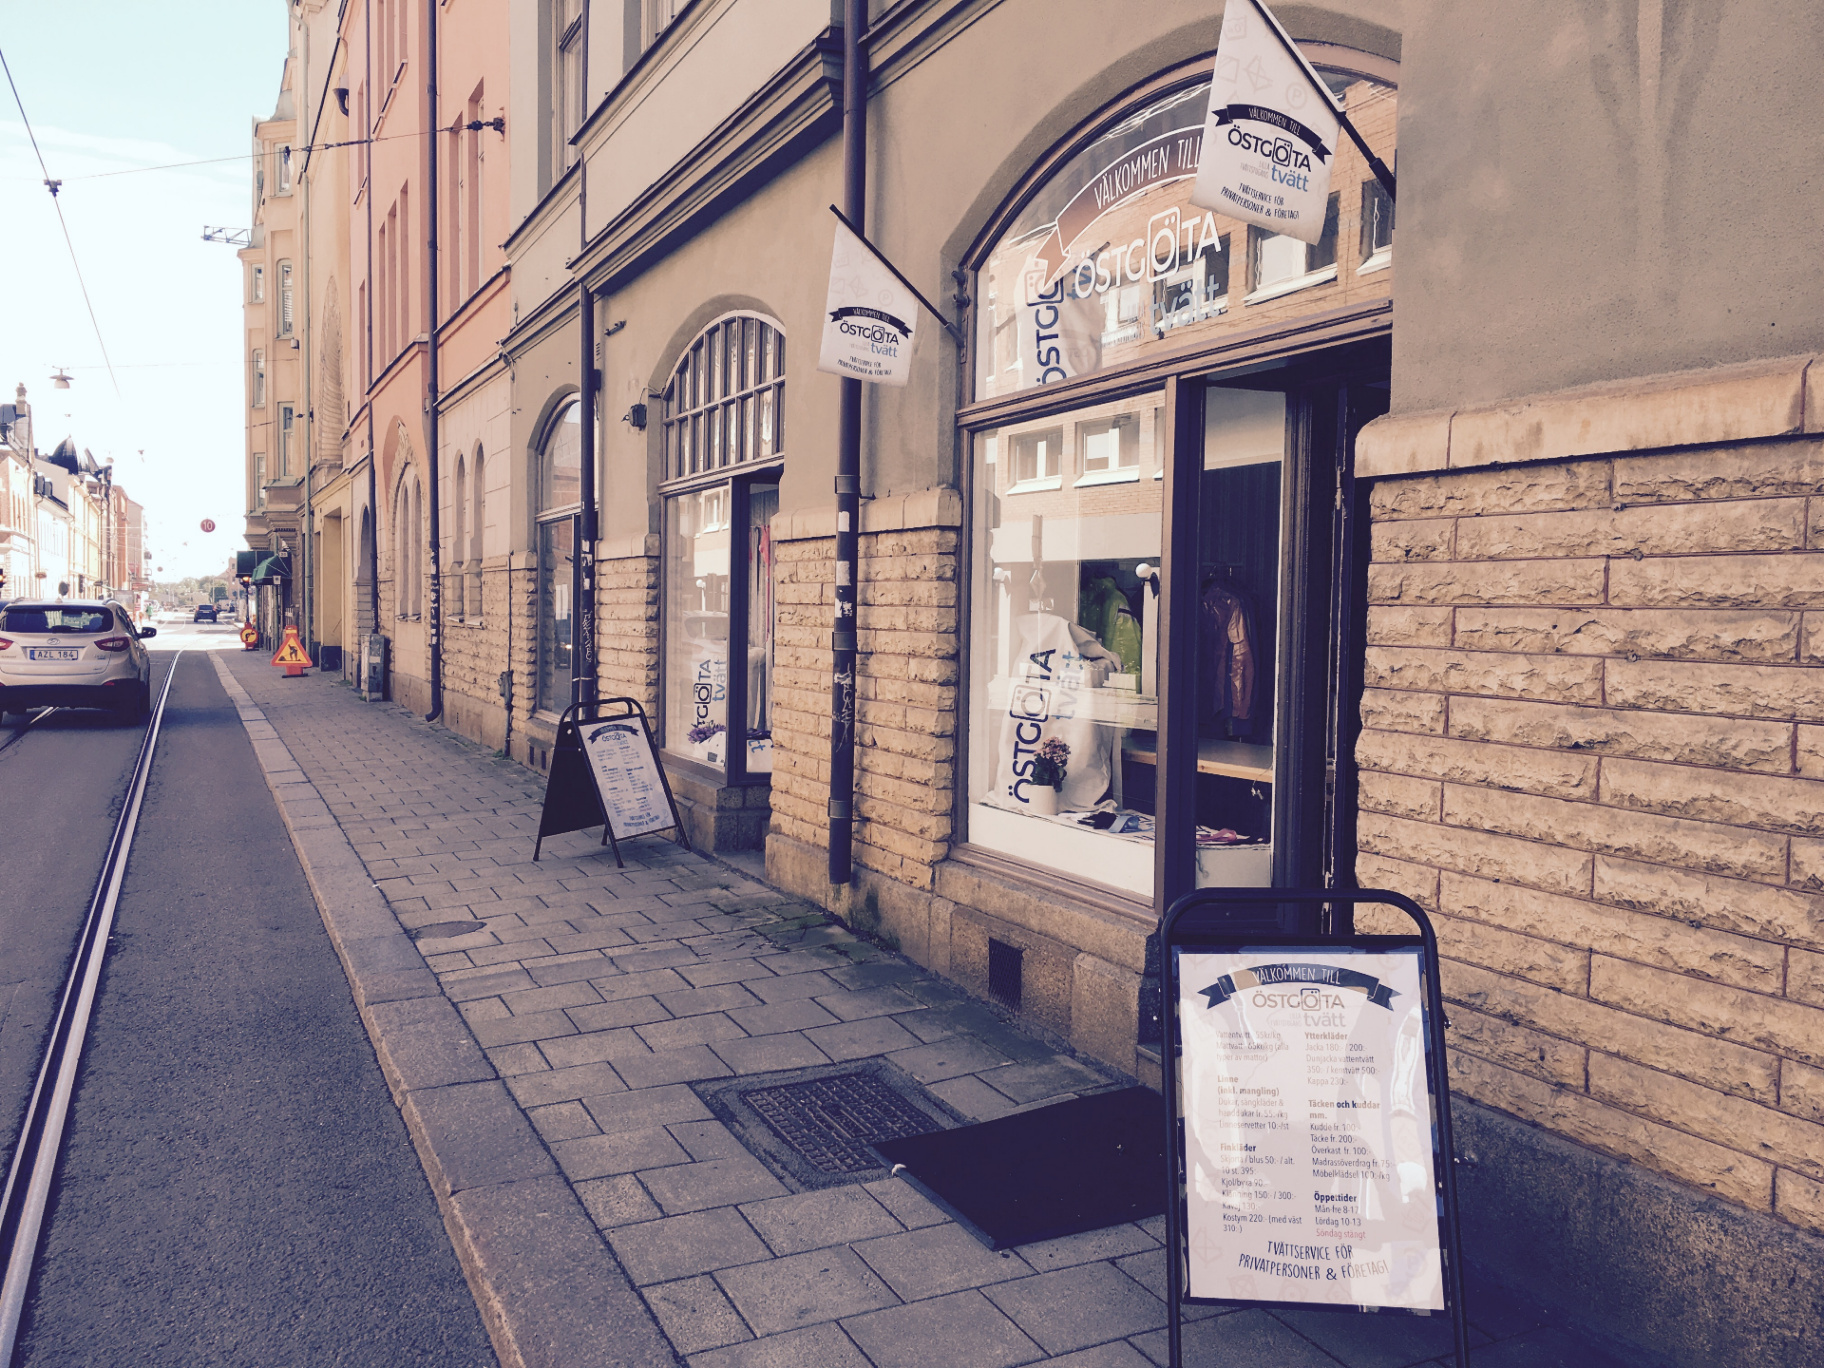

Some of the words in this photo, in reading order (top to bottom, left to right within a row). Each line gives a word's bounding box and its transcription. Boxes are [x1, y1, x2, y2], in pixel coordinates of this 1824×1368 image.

[1249, 107, 1287, 127] VÄLKOMMEN
[1289, 121, 1301, 136] TILL
[1228, 124, 1312, 172] ÖSTGÖTA
[1094, 144, 1170, 210] VÄLKOMMEN
[1271, 165, 1310, 192] tvätt
[1239, 183, 1272, 204] TVÄTTSERVICE
[1274, 195, 1285, 206] FÖR
[1221, 186, 1264, 214] PRIVATPERSONER
[1265, 208, 1272, 217] &
[1075, 207, 1221, 299] ÖSTGÖTA
[1149, 274, 1220, 335] tvätt
[840, 320, 899, 345] ÖSTGÖTA
[871, 342, 898, 358] tvätt
[203, 521, 213, 531] 10
[37, 651, 54, 659] AZL
[694, 659, 712, 725] TGÖTA
[1251, 966, 1315, 983] VÄLKOMMEN
[1322, 968, 1341, 985] TILL
[1252, 988, 1346, 1011] ÖSTGÖTA
[1303, 1012, 1346, 1027] tvätt
[1304, 1032, 1348, 1040] Ytterkläder
[1305, 1043, 1324, 1051] Jacka
[1349, 1043, 1367, 1052] 200:-
[1216, 1054, 1233, 1062] typer
[1339, 1055, 1374, 1063] vattentvätt
[1361, 1066, 1380, 1075] 500:-
[1307, 1077, 1329, 1086] Kappa
[1330, 1077, 1349, 1086] 230:-
[1239, 1087, 1280, 1097] mangling)
[1240, 1098, 1277, 1108] sängkläder
[1308, 1099, 1335, 1108] Täcken
[1336, 1100, 1350, 1108] och
[1351, 1100, 1380, 1109] kuddar
[1268, 1121, 1289, 1130] 10:-/st
[1310, 1123, 1333, 1131] Kudde
[1310, 1134, 1329, 1143] Täcke
[1338, 1135, 1358, 1143] 200:-
[1220, 1143, 1256, 1152] Finkläder
[1311, 1145, 1341, 1154] Överkast
[1353, 1147, 1371, 1155] 100:-
[1249, 1155, 1264, 1164] blus
[1284, 1157, 1295, 1165] alt.
[1312, 1157, 1371, 1169] Madrassöverdrag
[1231, 1167, 1239, 1175] st.
[1312, 1169, 1359, 1179] Möbelklädsel
[1254, 1191, 1272, 1199] 150:-
[1278, 1191, 1296, 1200] 300:-
[1314, 1190, 1357, 1203] Öppettider
[1223, 1213, 1248, 1224] Kostym
[1249, 1214, 1267, 1223] 220:-
[1268, 1215, 1287, 1224] (med
[1288, 1216, 1302, 1224] väst
[1315, 1216, 1340, 1228] Lördag
[1316, 1228, 1342, 1240] Söndag
[1344, 1230, 1366, 1241] stängt
[1268, 1240, 1331, 1261] TVÄTTSERVICE
[1335, 1243, 1354, 1260] FÖR
[1238, 1253, 1320, 1280] PRIVATPERSONER
[1326, 1268, 1337, 1280] &
[1341, 1259, 1390, 1279] FÖRETAG!
